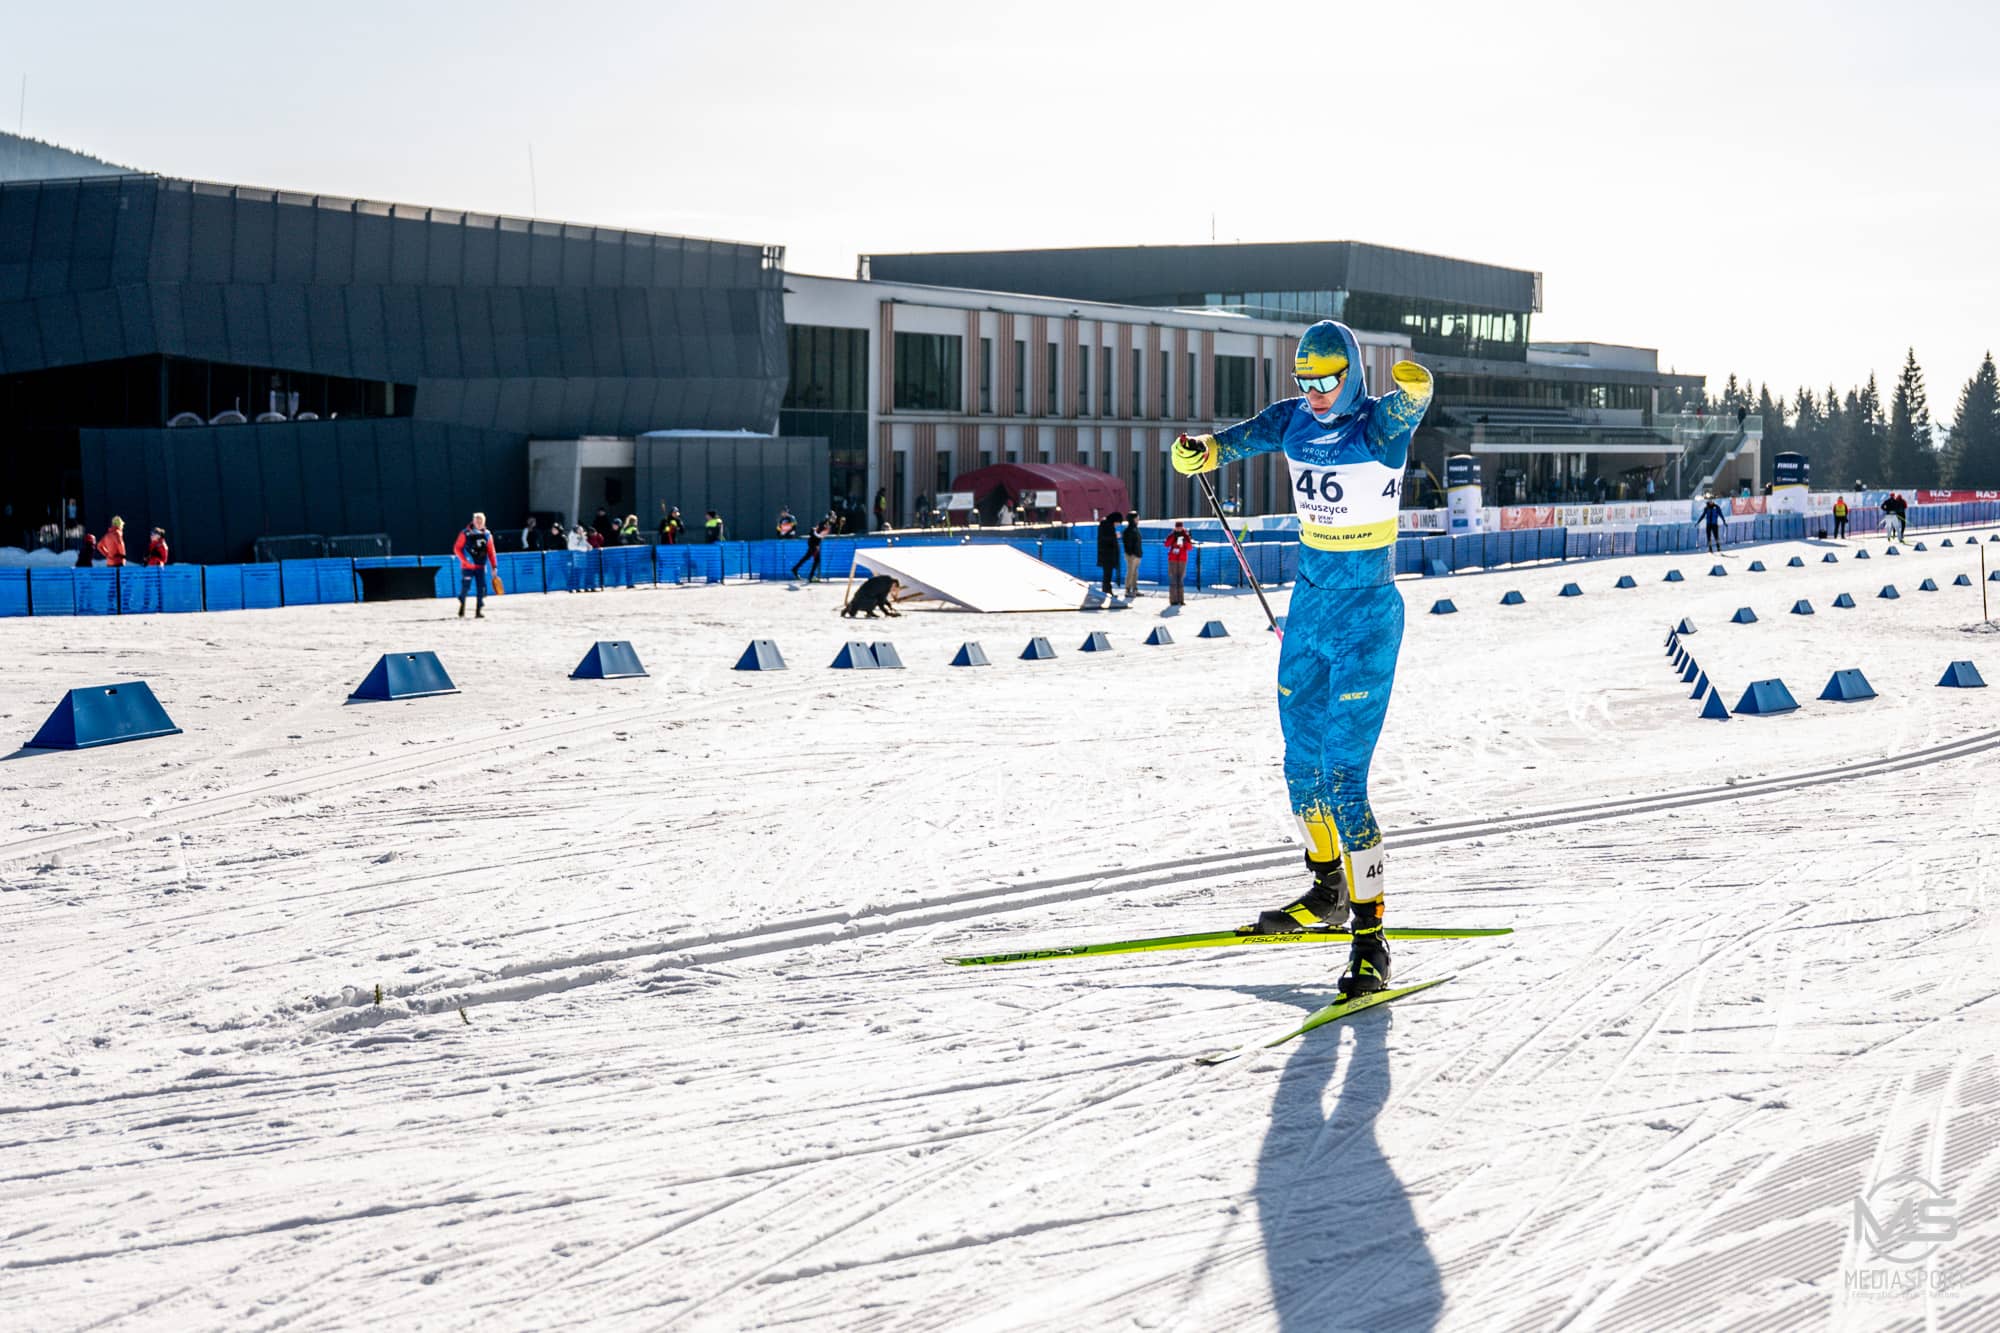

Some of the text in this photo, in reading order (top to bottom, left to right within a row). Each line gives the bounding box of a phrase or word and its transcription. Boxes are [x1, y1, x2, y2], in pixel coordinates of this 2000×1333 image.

[1296, 470, 1343, 502] 46
[1420, 514, 1438, 528] IMPEL
[1366, 859, 1384, 878] 46
[1243, 935, 1303, 944] FISCHER
